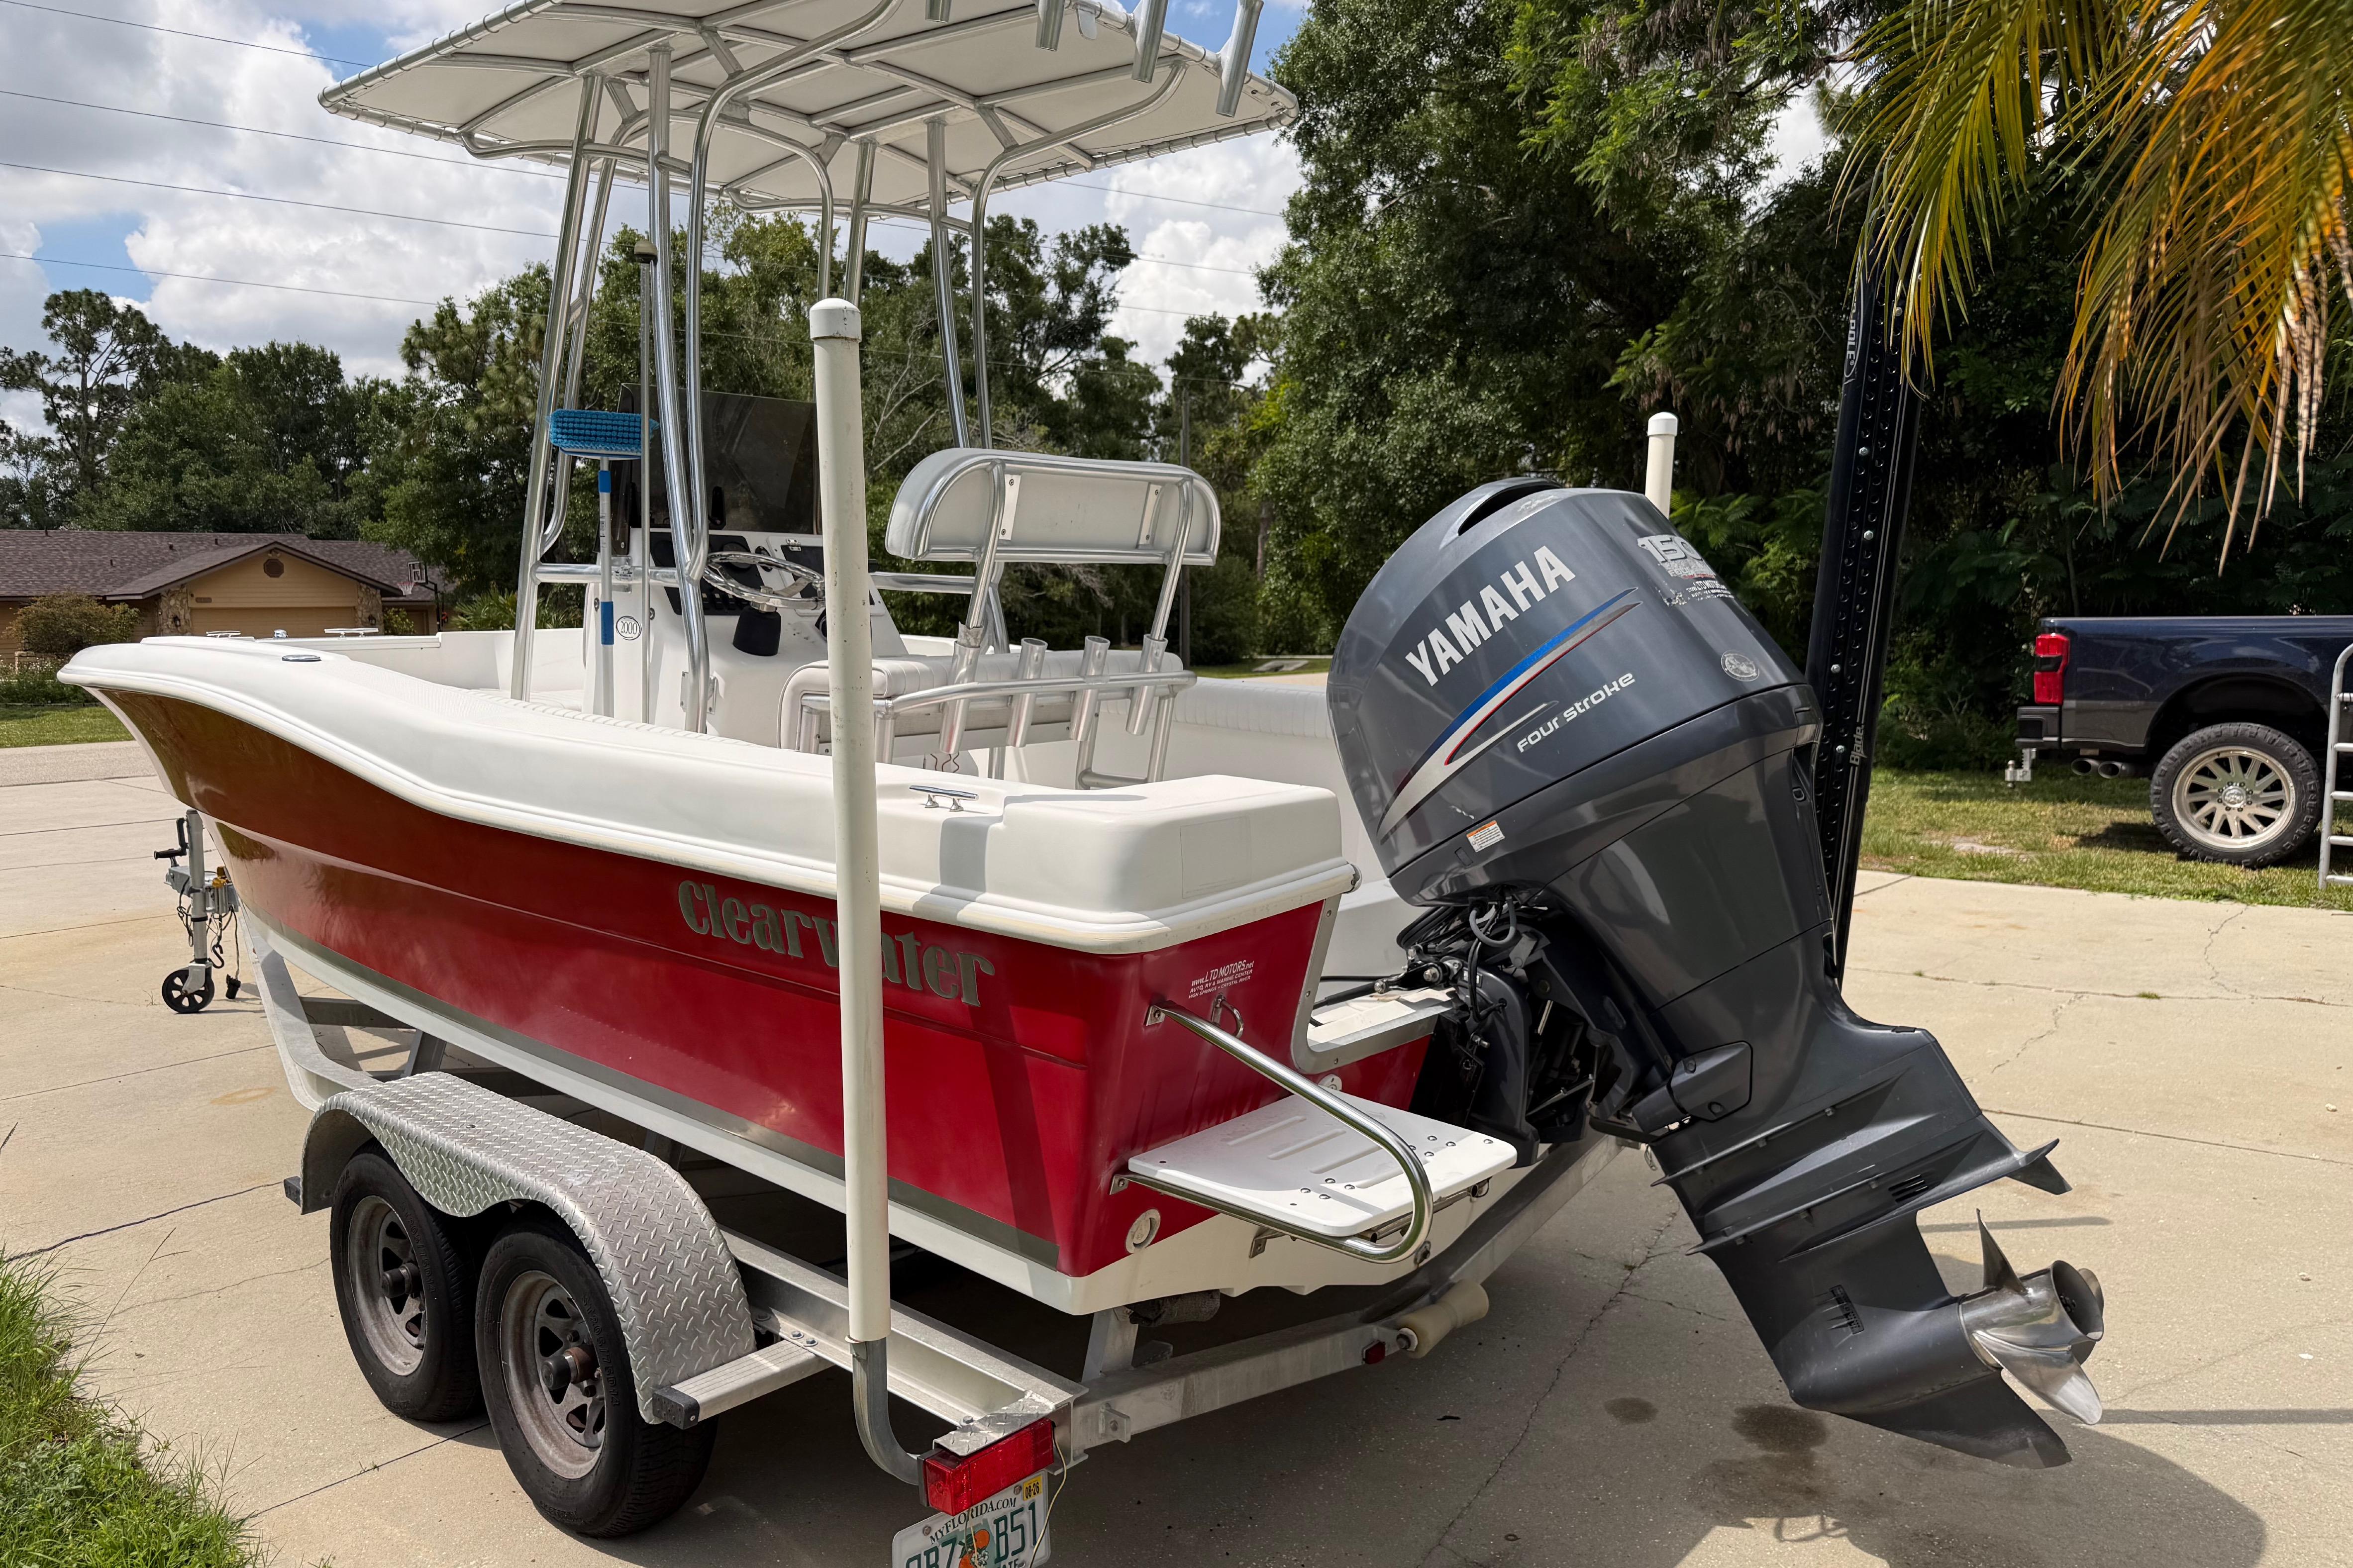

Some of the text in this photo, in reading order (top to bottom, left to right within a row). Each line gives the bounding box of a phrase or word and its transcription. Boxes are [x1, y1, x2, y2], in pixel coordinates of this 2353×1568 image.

[1637, 534, 1703, 563] 150
[620, 621, 637, 635] 2000
[1405, 545, 1576, 687] YAMAHA
[1849, 726, 1865, 766] Blade
[1200, 986, 1217, 996] SPRINGS
[1221, 980, 1238, 989] CRYSTAL
[1217, 975, 1234, 984] MARINE
[1234, 970, 1253, 979] CENTER
[1025, 1481, 1039, 1499] 08-26
[929, 1497, 1017, 1545] MYFLORIDA.COM
[994, 1501, 1036, 1564] B51
